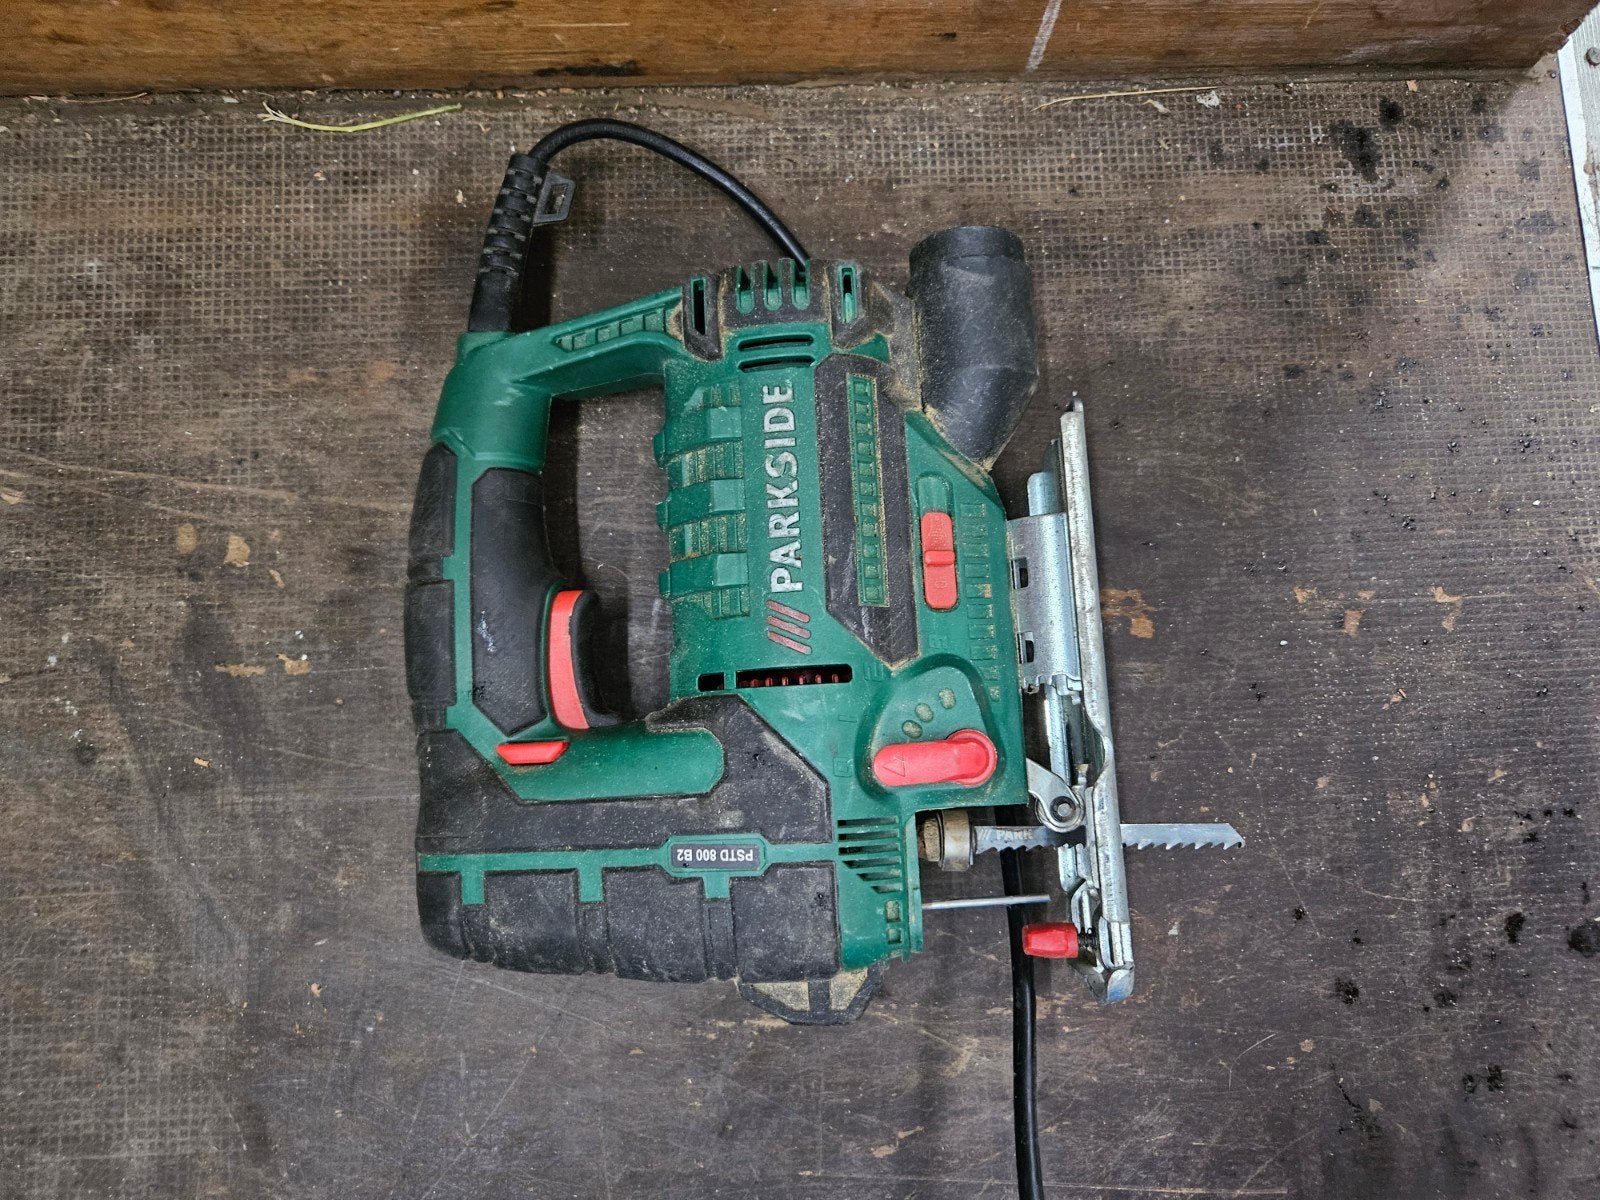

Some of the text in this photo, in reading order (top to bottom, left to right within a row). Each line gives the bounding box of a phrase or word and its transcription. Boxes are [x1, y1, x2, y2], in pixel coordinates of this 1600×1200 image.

[763, 385, 803, 593] PARKSIDE
[676, 848, 754, 862] PSTD 800 B2
